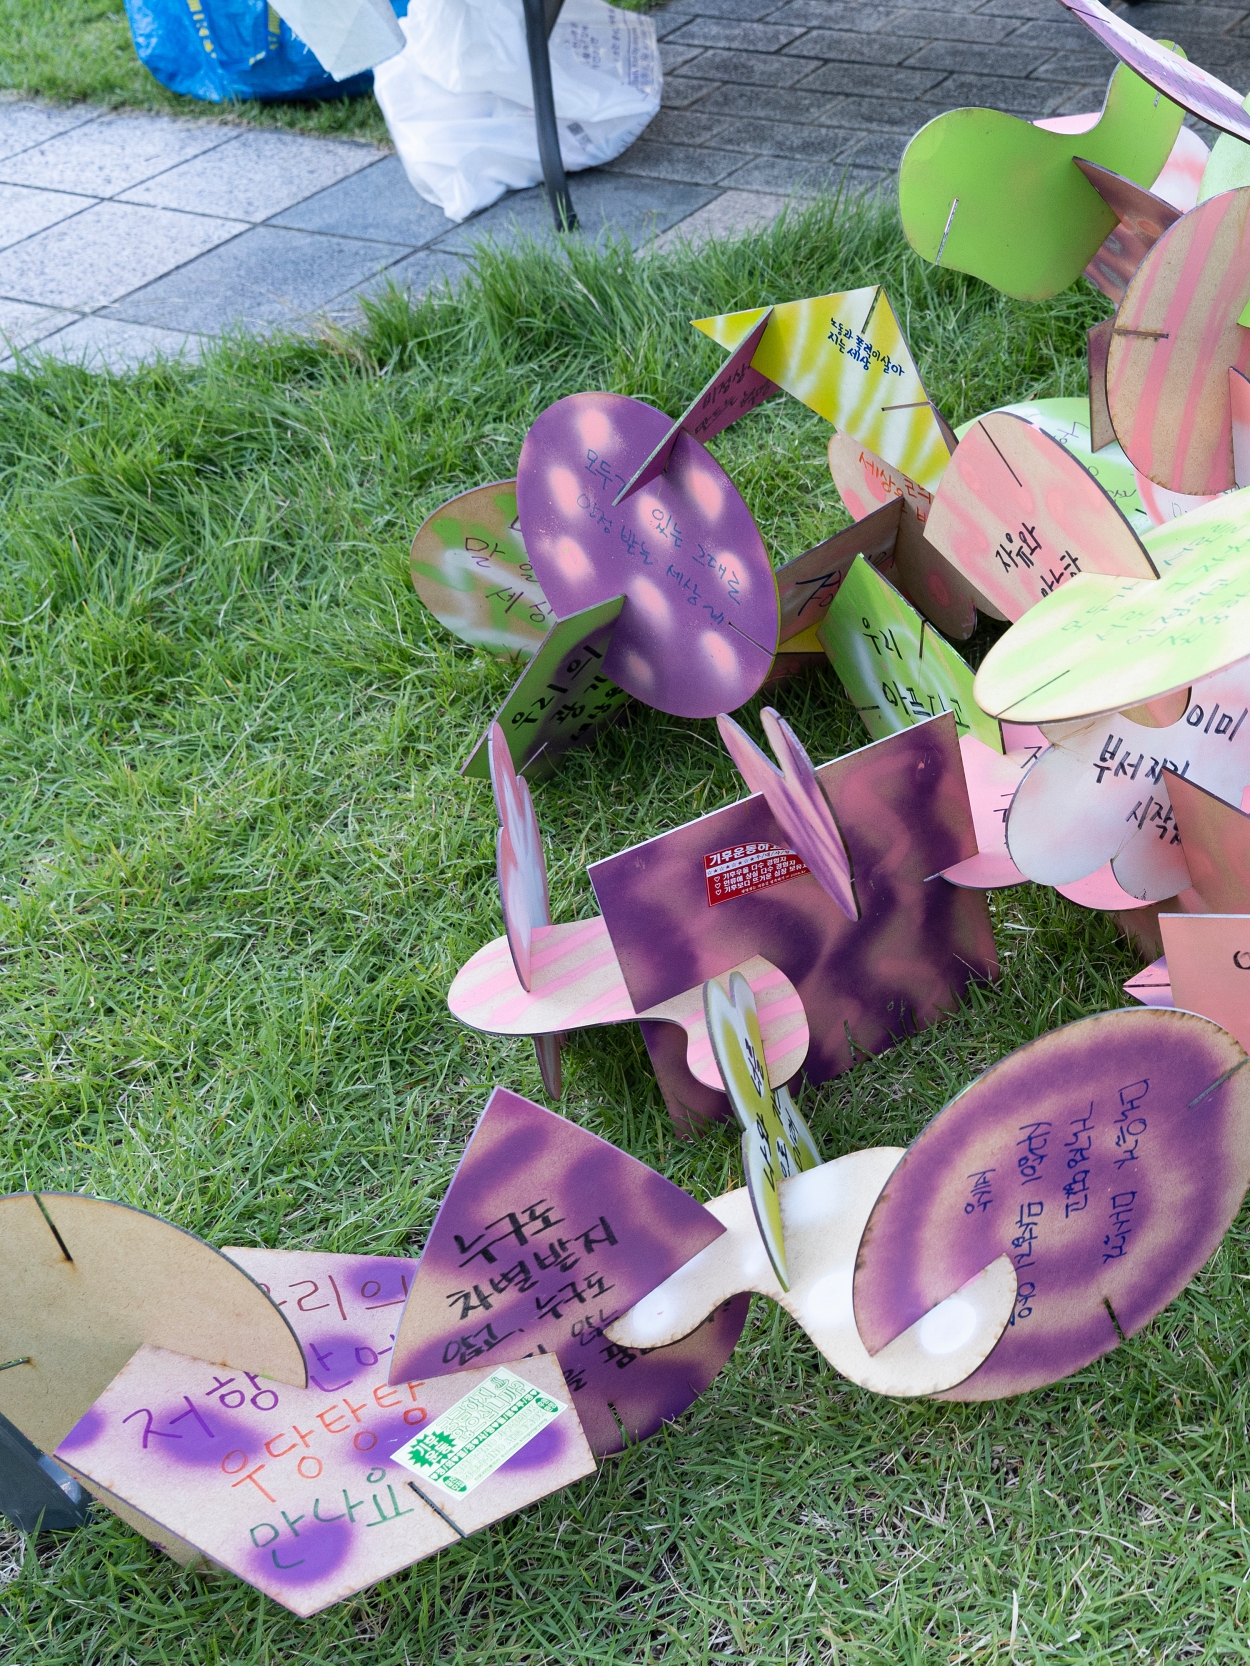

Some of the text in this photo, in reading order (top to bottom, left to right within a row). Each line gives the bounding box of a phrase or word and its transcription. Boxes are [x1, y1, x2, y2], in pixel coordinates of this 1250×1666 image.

[828, 331, 871, 370] 지는 세상
[830, 317, 853, 340] 노동과
[994, 523, 1042, 573] 자유와
[666, 564, 701, 606] 세상
[862, 617, 903, 660] 우리
[1186, 703, 1248, 742] 이미
[964, 1168, 996, 1214] 세상
[453, 1199, 566, 1268] 누구도
[263, 1274, 409, 1321] 리의
[536, 1271, 615, 1320] 누구도
[221, 1381, 428, 1504] 우당탕탕
[411, 1432, 443, 1456] 기후
[423, 1439, 454, 1464] 운동
[251, 1467, 415, 1569] 만나요
